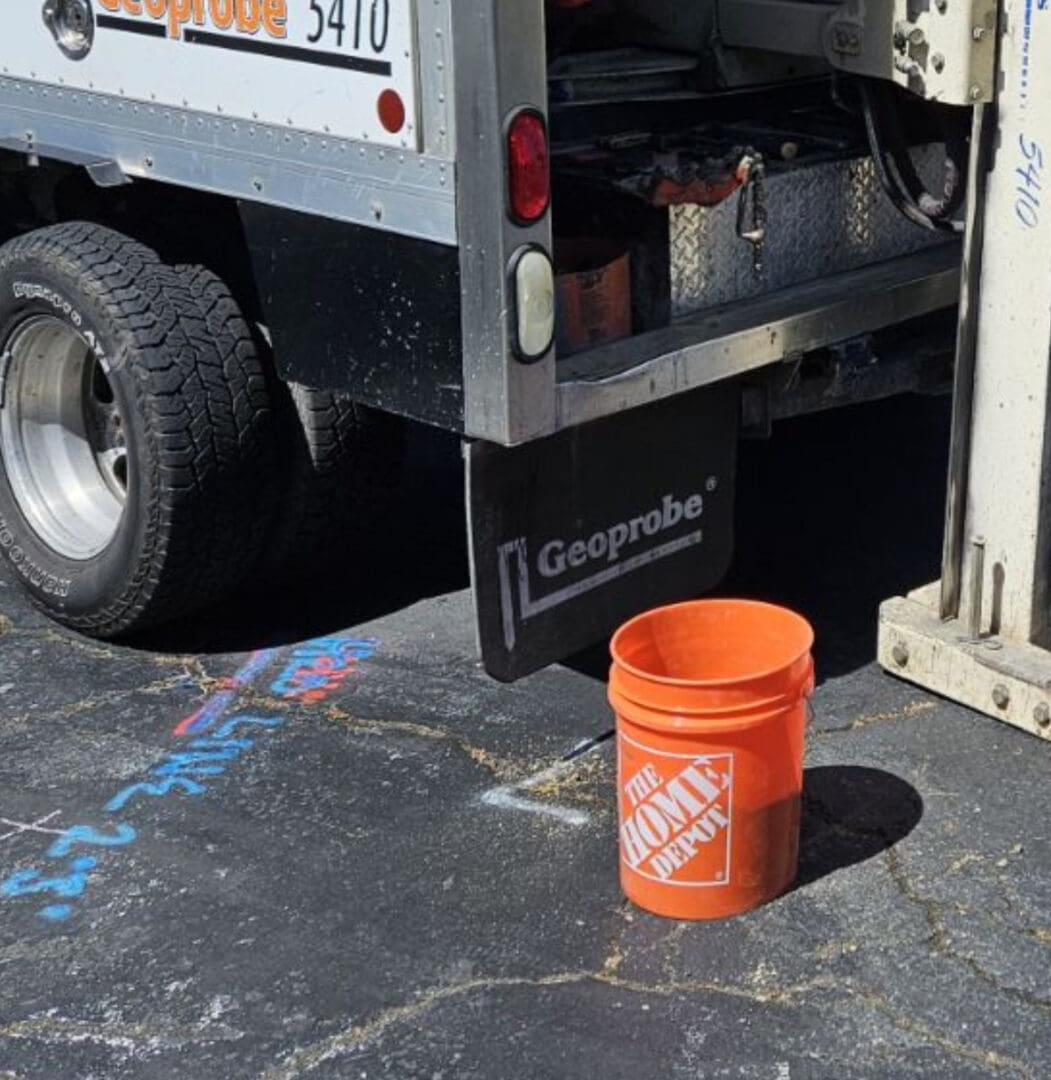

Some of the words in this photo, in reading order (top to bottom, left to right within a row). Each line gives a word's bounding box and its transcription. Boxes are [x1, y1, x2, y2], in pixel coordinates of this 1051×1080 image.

[1015, 133, 1043, 229] 5410
[536, 493, 703, 578] Geoprobe
[620, 756, 731, 868] HOME
[624, 762, 664, 807] THE
[649, 804, 730, 881] DEPOT
